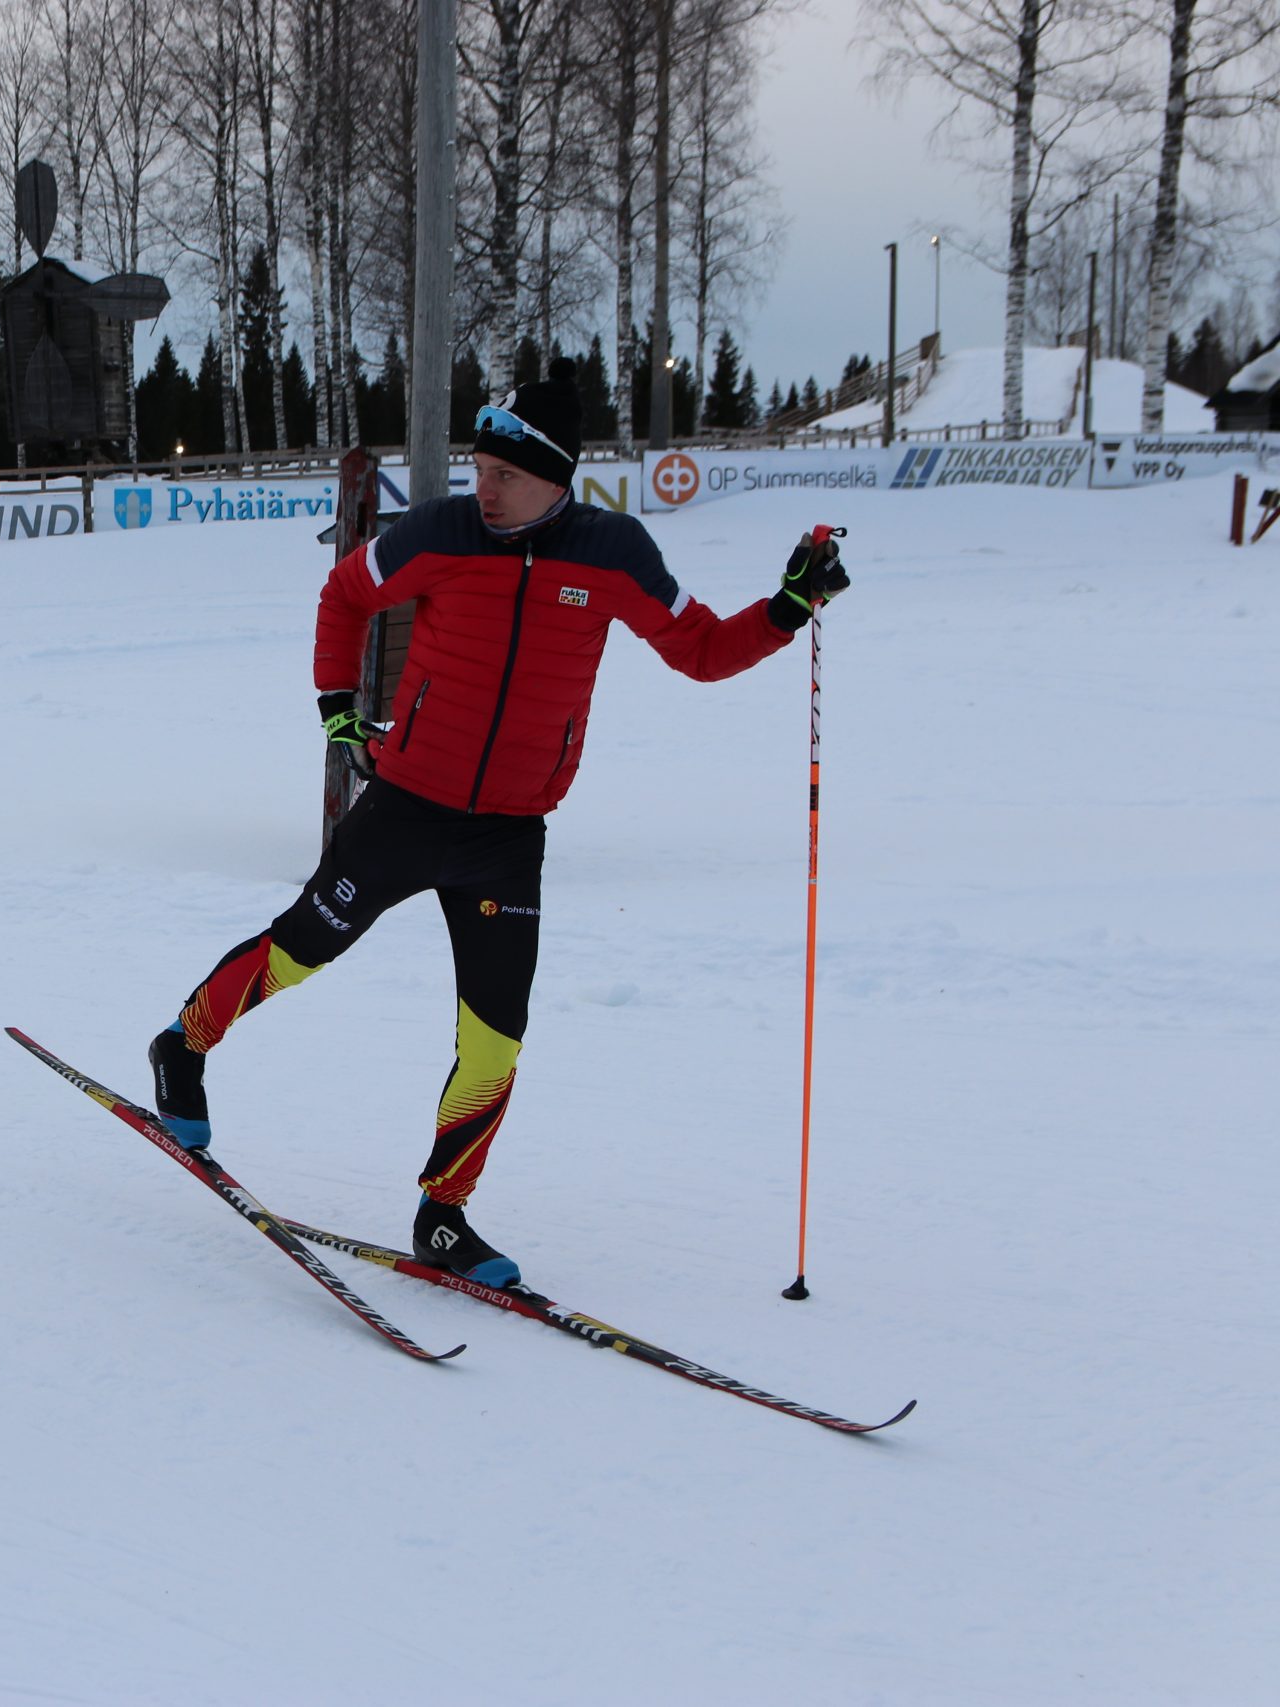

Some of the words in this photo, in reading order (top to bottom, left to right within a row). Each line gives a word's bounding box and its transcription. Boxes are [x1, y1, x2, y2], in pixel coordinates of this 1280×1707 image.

[945, 447, 1089, 467] TIKKAKOSKEN
[708, 467, 738, 491] OP
[743, 464, 877, 491] Suomenselkä
[1045, 468, 1078, 488] OY
[1132, 462, 1161, 479] VPP
[1165, 461, 1186, 481] Oy
[167, 487, 333, 524] Pyhäjärvi
[562, 589, 587, 599] rukka
[501, 905, 526, 915] Pohti
[142, 1123, 194, 1167] PELTONEN
[440, 1274, 513, 1308] PELTONEN
